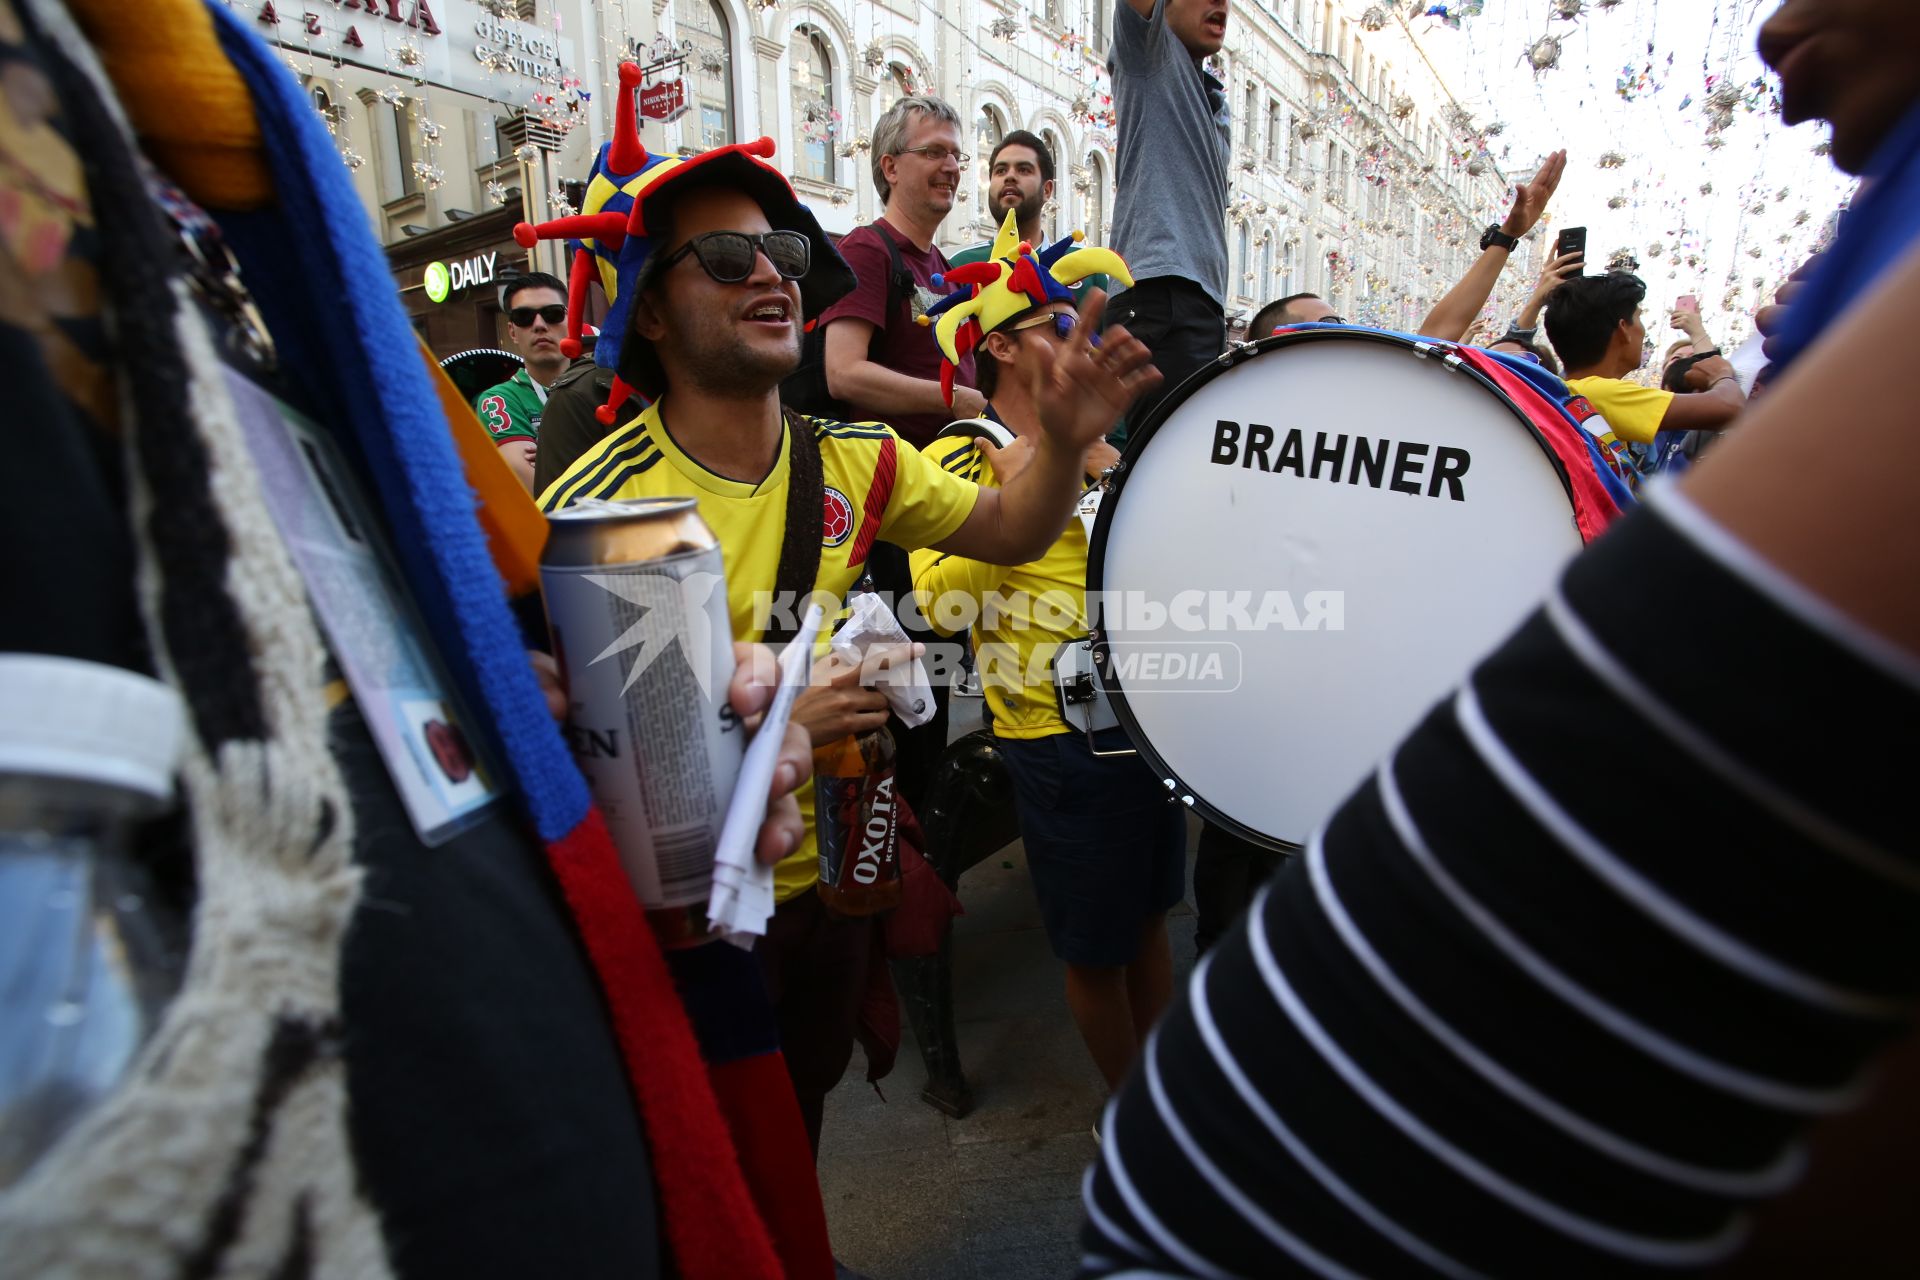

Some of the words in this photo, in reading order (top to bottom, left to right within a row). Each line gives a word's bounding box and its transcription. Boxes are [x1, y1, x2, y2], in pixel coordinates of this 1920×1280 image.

[475, 20, 554, 61] OFFICE
[450, 251, 497, 291] DAILY
[481, 395, 513, 434] 3
[1211, 419, 1471, 502] BRAHNER
[853, 776, 894, 885] ОХОТА
